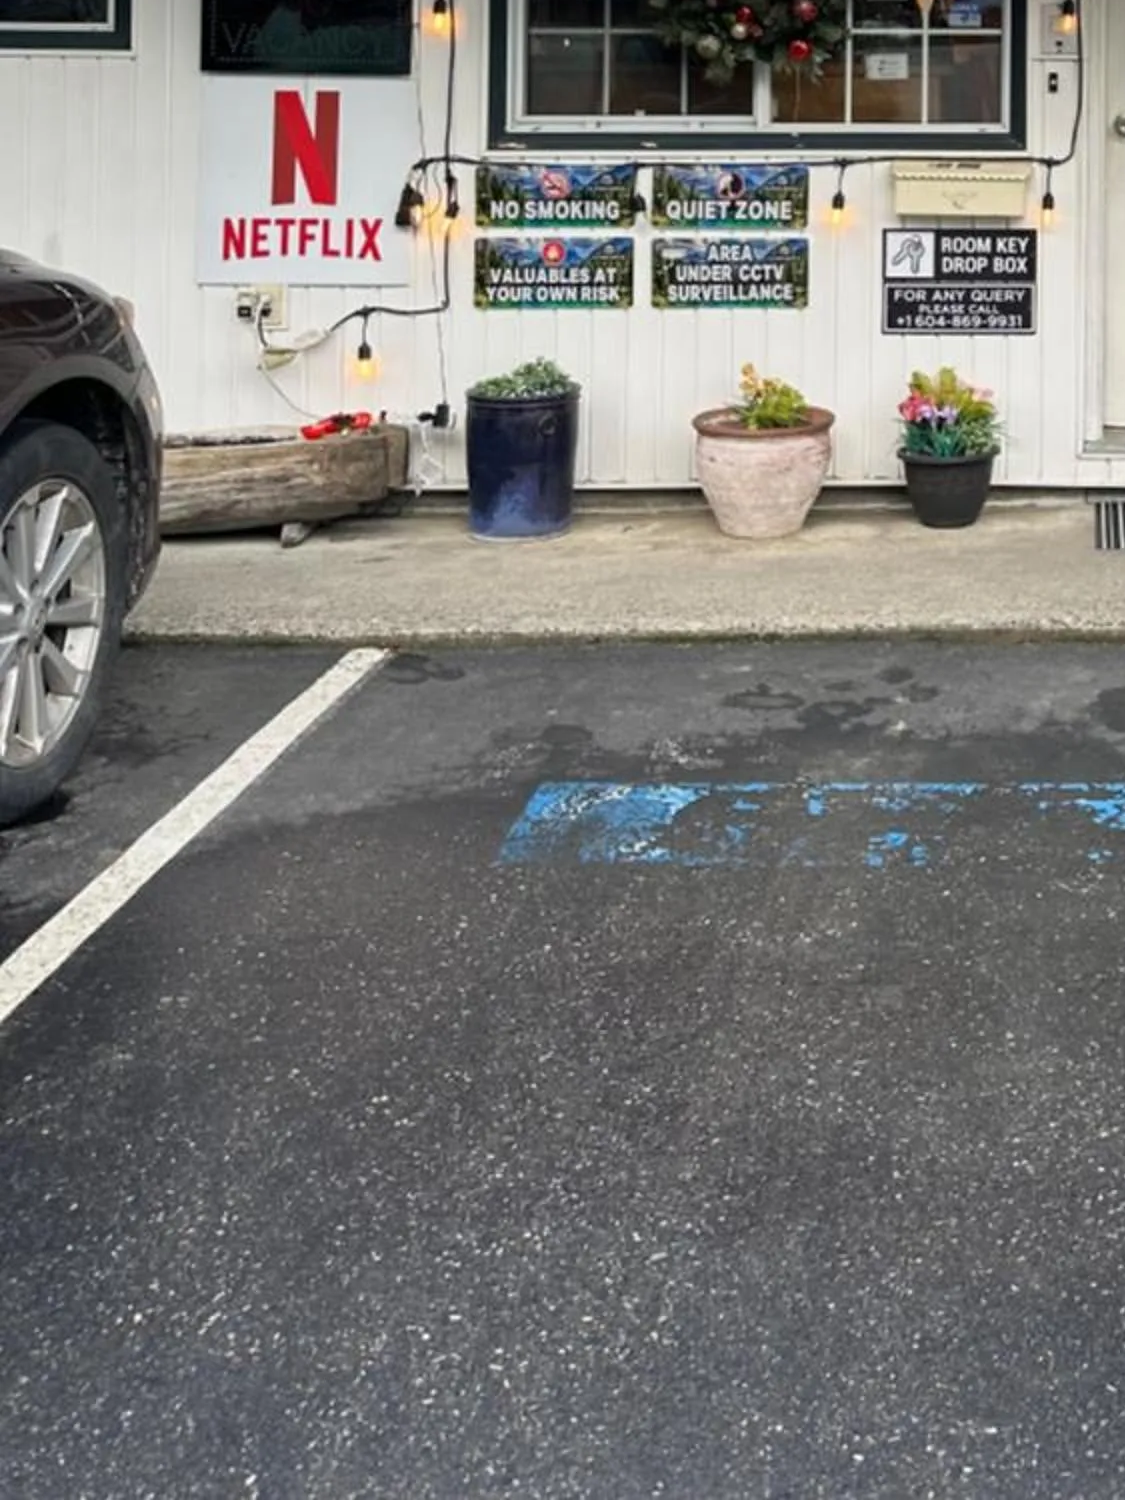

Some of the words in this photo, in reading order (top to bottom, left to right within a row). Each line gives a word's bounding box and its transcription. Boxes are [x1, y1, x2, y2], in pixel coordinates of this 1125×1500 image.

[271, 90, 340, 205] N
[490, 200, 520, 220] NO
[525, 200, 620, 219] SMOKING
[666, 200, 729, 220] QUIET
[735, 201, 792, 220] ZONE
[222, 218, 382, 261] NETFLIX
[941, 237, 992, 254] ROOM
[996, 238, 1030, 254] KEY
[707, 245, 753, 262] AREA
[675, 265, 732, 282] UNDER
[738, 265, 785, 282] CCTV
[942, 257, 989, 274] DROP
[993, 257, 1028, 274] BOX
[490, 267, 590, 284] VALUABLES
[594, 268, 616, 284] AT
[487, 285, 534, 302] YOUR
[537, 286, 577, 302] OWN
[581, 286, 620, 302] RISK
[667, 283, 794, 301] SURVEILLANCE
[893, 289, 928, 302] FOR
[931, 289, 966, 302] ANY
[970, 289, 1026, 303] QUERY
[918, 304, 965, 315] PLEASE
[968, 305, 1000, 315] CALL
